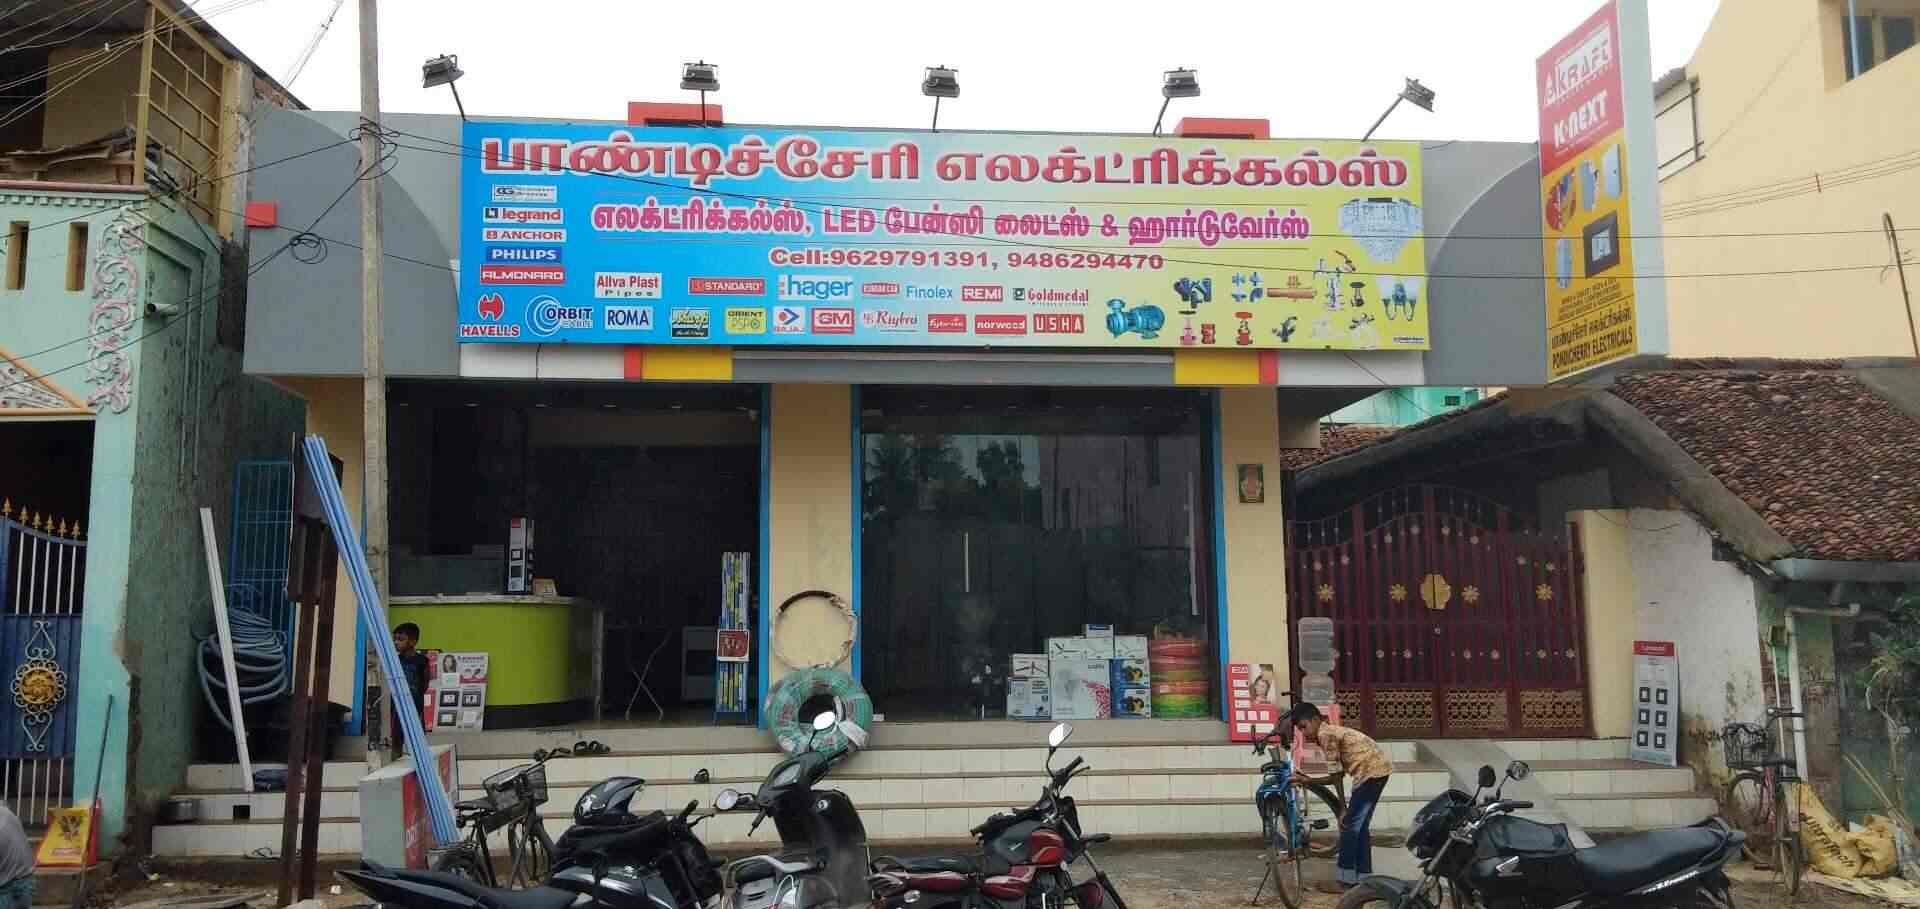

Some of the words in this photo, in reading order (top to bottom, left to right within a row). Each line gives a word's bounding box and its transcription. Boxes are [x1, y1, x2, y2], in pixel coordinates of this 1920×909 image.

[483, 133, 920, 186] பாண்டிச்சேரி
[935, 145, 1409, 188] எலக்ட்ரிக்கல்ஸ்
[503, 208, 561, 223] legrand
[824, 207, 876, 234] LED
[1101, 213, 1120, 236] &
[501, 231, 563, 240] ANCHOR
[491, 249, 557, 260] PHILIPS
[1007, 252, 1164, 270] 9486294470
[482, 271, 564, 280] ALMONARD
[629, 275, 659, 289] Plast
[704, 280, 762, 291] STANDARD
[788, 275, 853, 300] hager
[906, 285, 953, 299] Finolex
[963, 288, 1003, 300] REMI
[1027, 288, 1089, 301] Goldmedal
[546, 307, 593, 320] ORBIT
[607, 309, 650, 326] ROMA
[818, 312, 850, 325] GM
[976, 319, 1026, 330] norwood
[1035, 315, 1084, 332] USHA
[461, 325, 520, 337] HAVELLS
